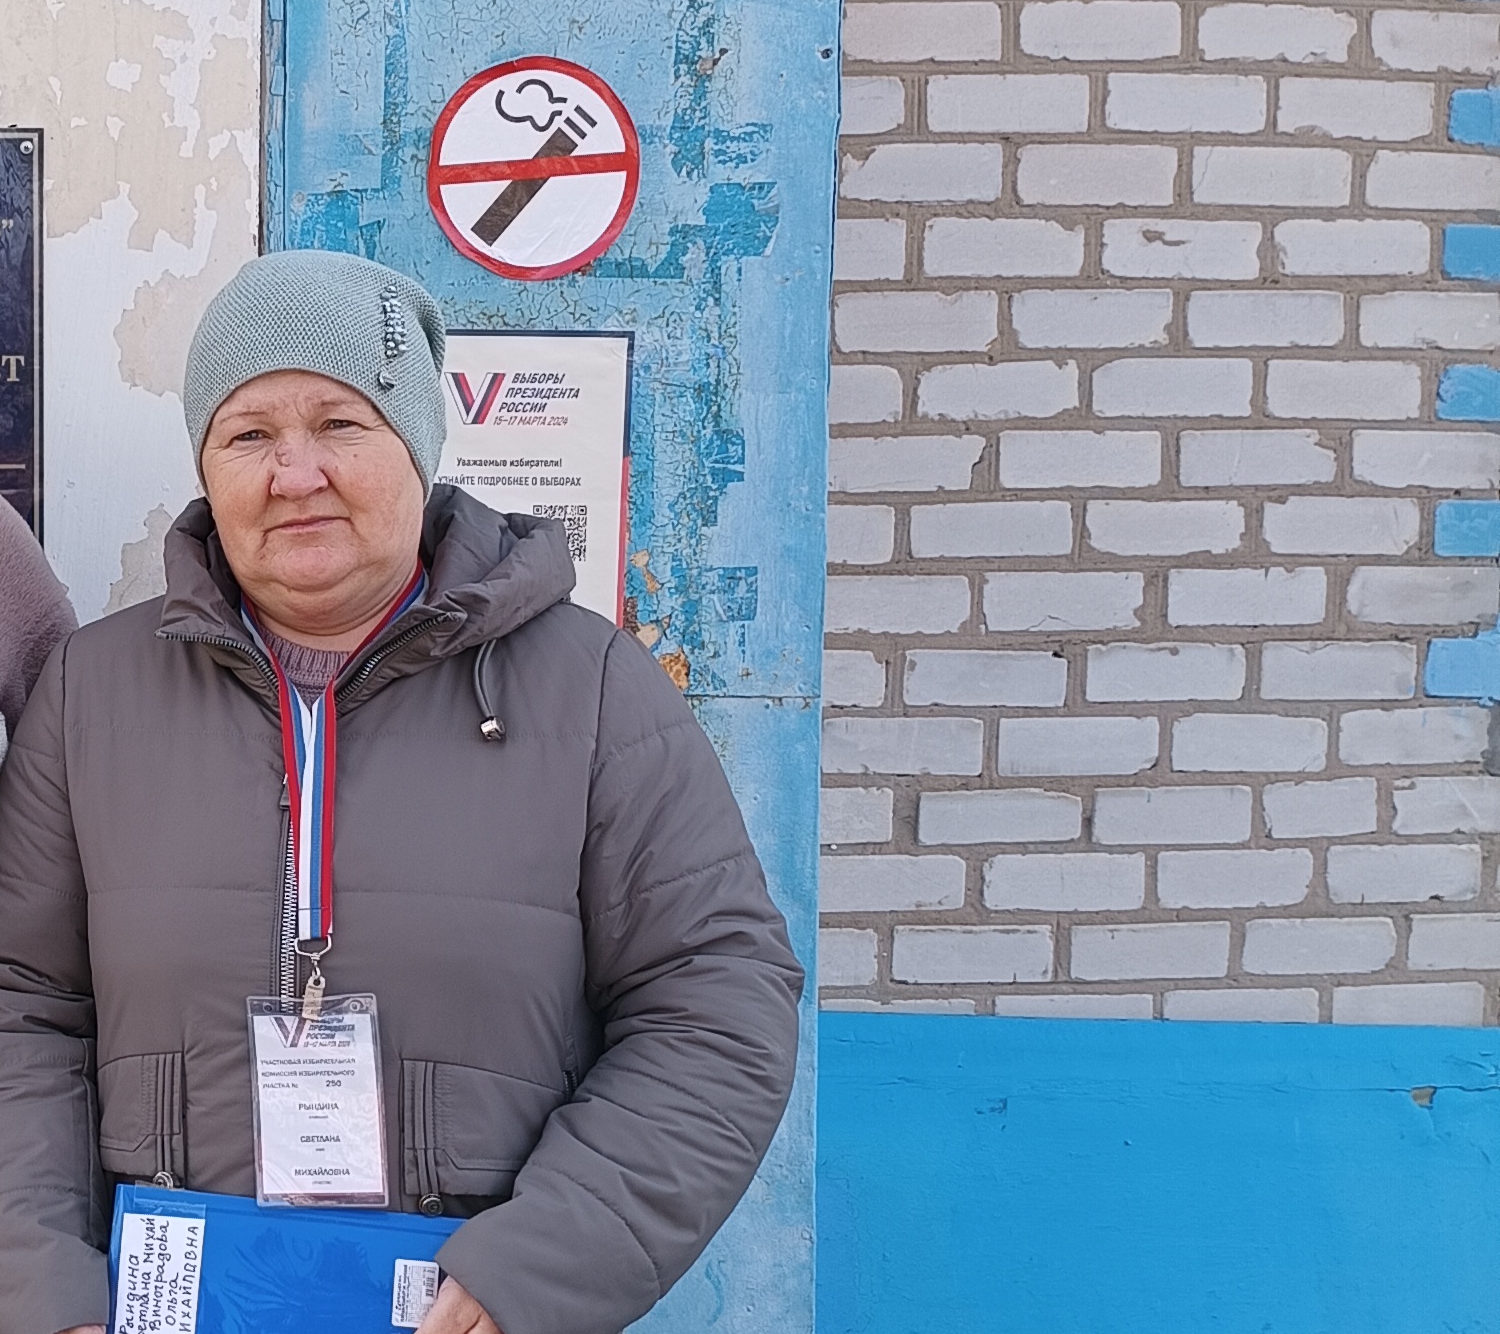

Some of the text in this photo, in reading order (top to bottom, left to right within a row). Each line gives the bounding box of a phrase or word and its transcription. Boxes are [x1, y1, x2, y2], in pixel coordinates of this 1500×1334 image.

[511, 372, 566, 384] ВЫБОРЫ
[505, 387, 580, 400] ПРЕЗИДЕНТА
[499, 401, 548, 413] РОССИИ
[517, 416, 546, 426] МАРТА
[547, 416, 569, 426] 2024
[456, 457, 563, 469] Уважаемые избиратели!
[438, 474, 582, 487] УЗНАЙТЕ ПОДРОБНЕЕ О ВЫБОРАХ
[325, 1079, 342, 1088] 250
[300, 1134, 341, 1143] СВЕТЛАНА
[294, 1166, 351, 1177] МИХАЙЛОВНА
[150, 1220, 172, 1331] Виноградова
